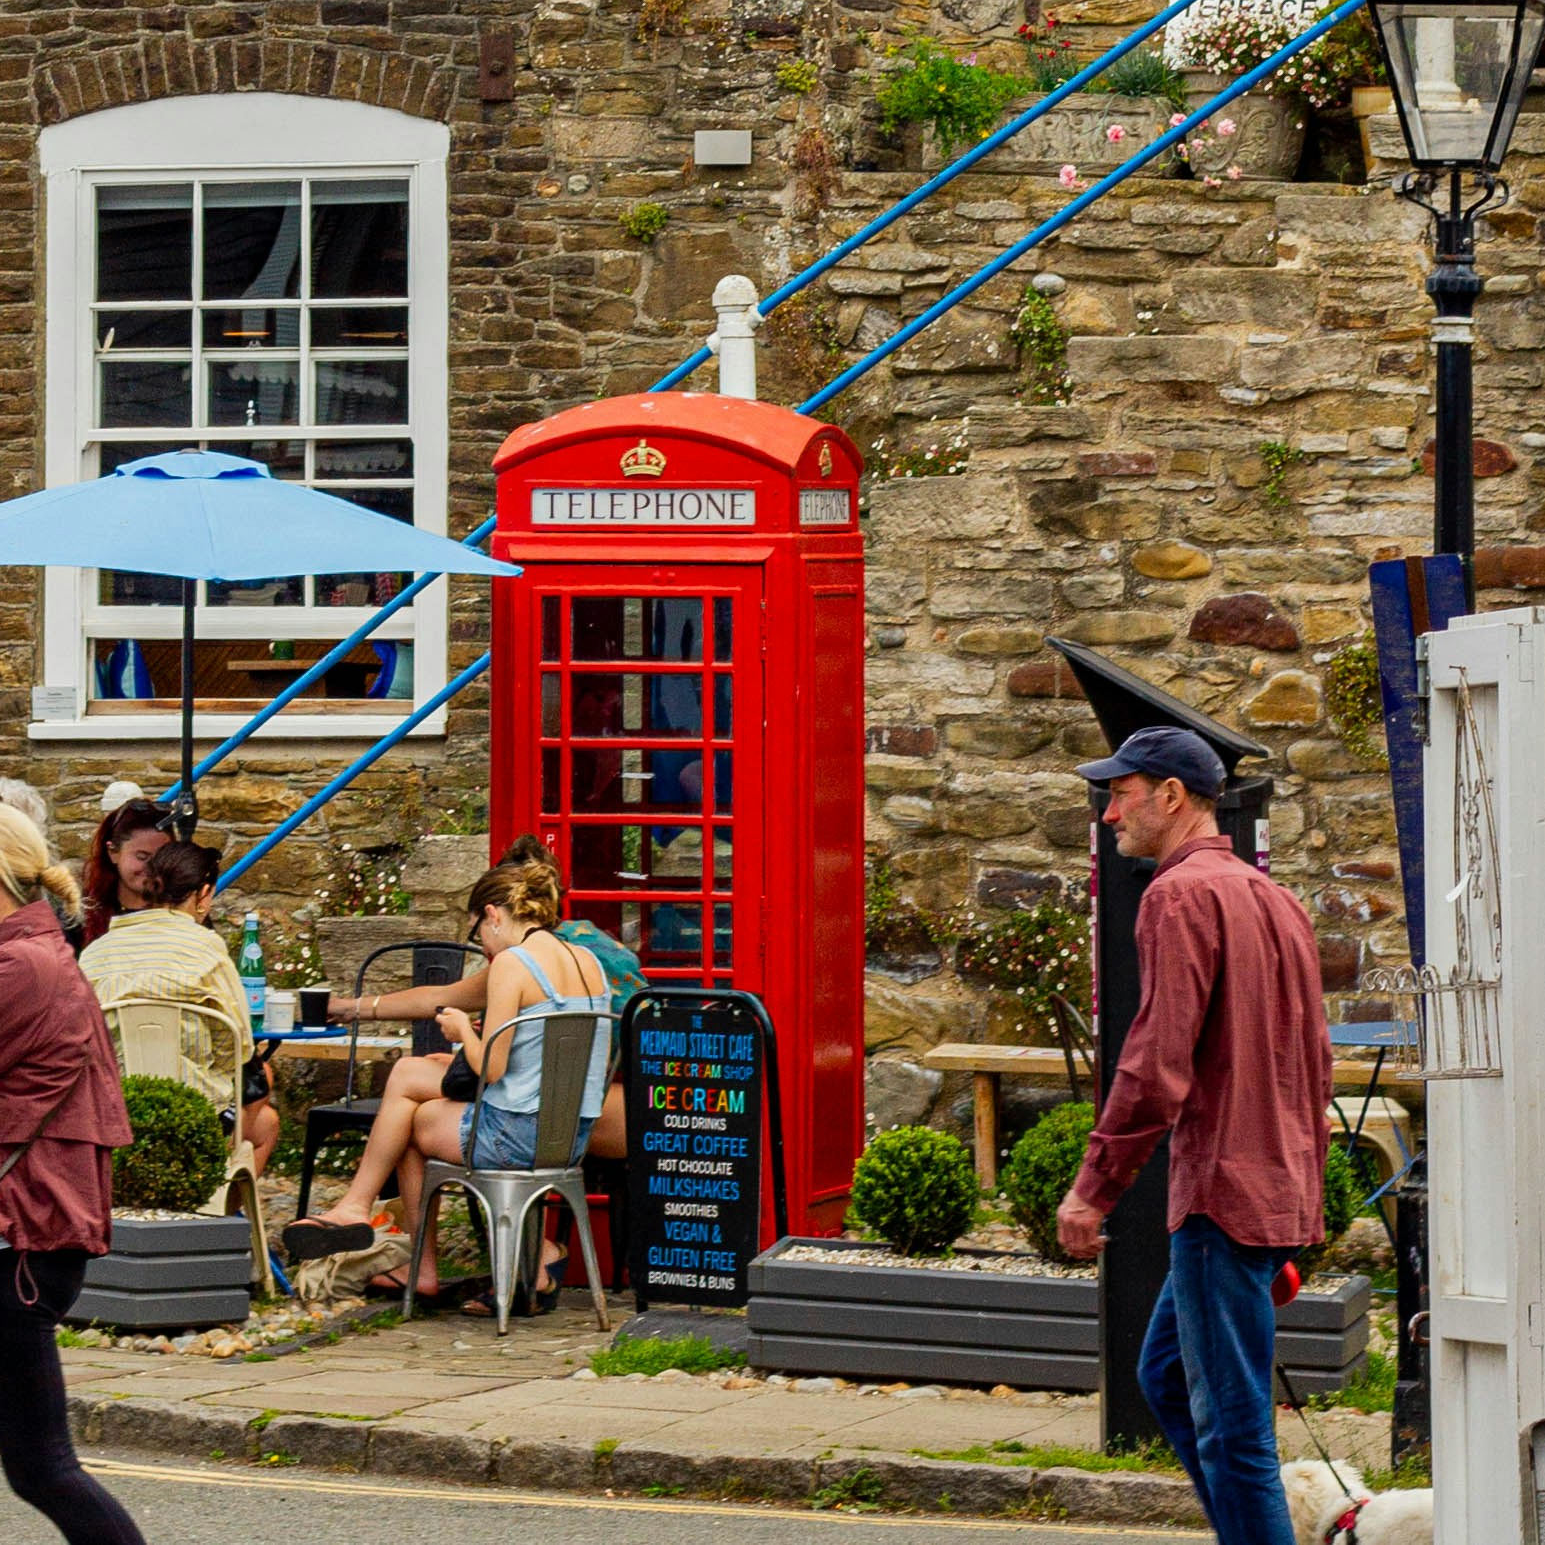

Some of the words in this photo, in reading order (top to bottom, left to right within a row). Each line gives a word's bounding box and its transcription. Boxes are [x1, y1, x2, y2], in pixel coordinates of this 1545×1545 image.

[542, 491, 747, 521] TELEPHONE
[800, 493, 848, 521] TELEPHONE
[640, 1030, 687, 1058] MERMAID
[689, 1032, 726, 1059] STREET
[729, 1032, 754, 1061] CAFÉ
[640, 1060, 663, 1076] THE
[664, 1061, 682, 1077] ICE
[683, 1063, 722, 1079] CREAM
[723, 1064, 754, 1081] SHOP
[648, 1085, 677, 1110] ICE
[681, 1087, 745, 1114] CREAM
[664, 1114, 690, 1129] COLD
[691, 1116, 727, 1131] DRINKS
[643, 1131, 690, 1153] GREAT
[693, 1135, 749, 1157] COFFEE
[657, 1159, 678, 1171] HOT
[678, 1160, 733, 1175] CHOCOLATE
[648, 1176, 740, 1200] MILKSHAKES
[664, 1202, 719, 1218] SMOOTHIES
[664, 1220, 709, 1242] VEGAN
[711, 1224, 722, 1244] &
[648, 1246, 700, 1268] GLUTEN
[703, 1250, 737, 1272] FREE
[648, 1271, 697, 1287] BROWNIES
[699, 1274, 707, 1288] &
[708, 1275, 736, 1290] BUNS
